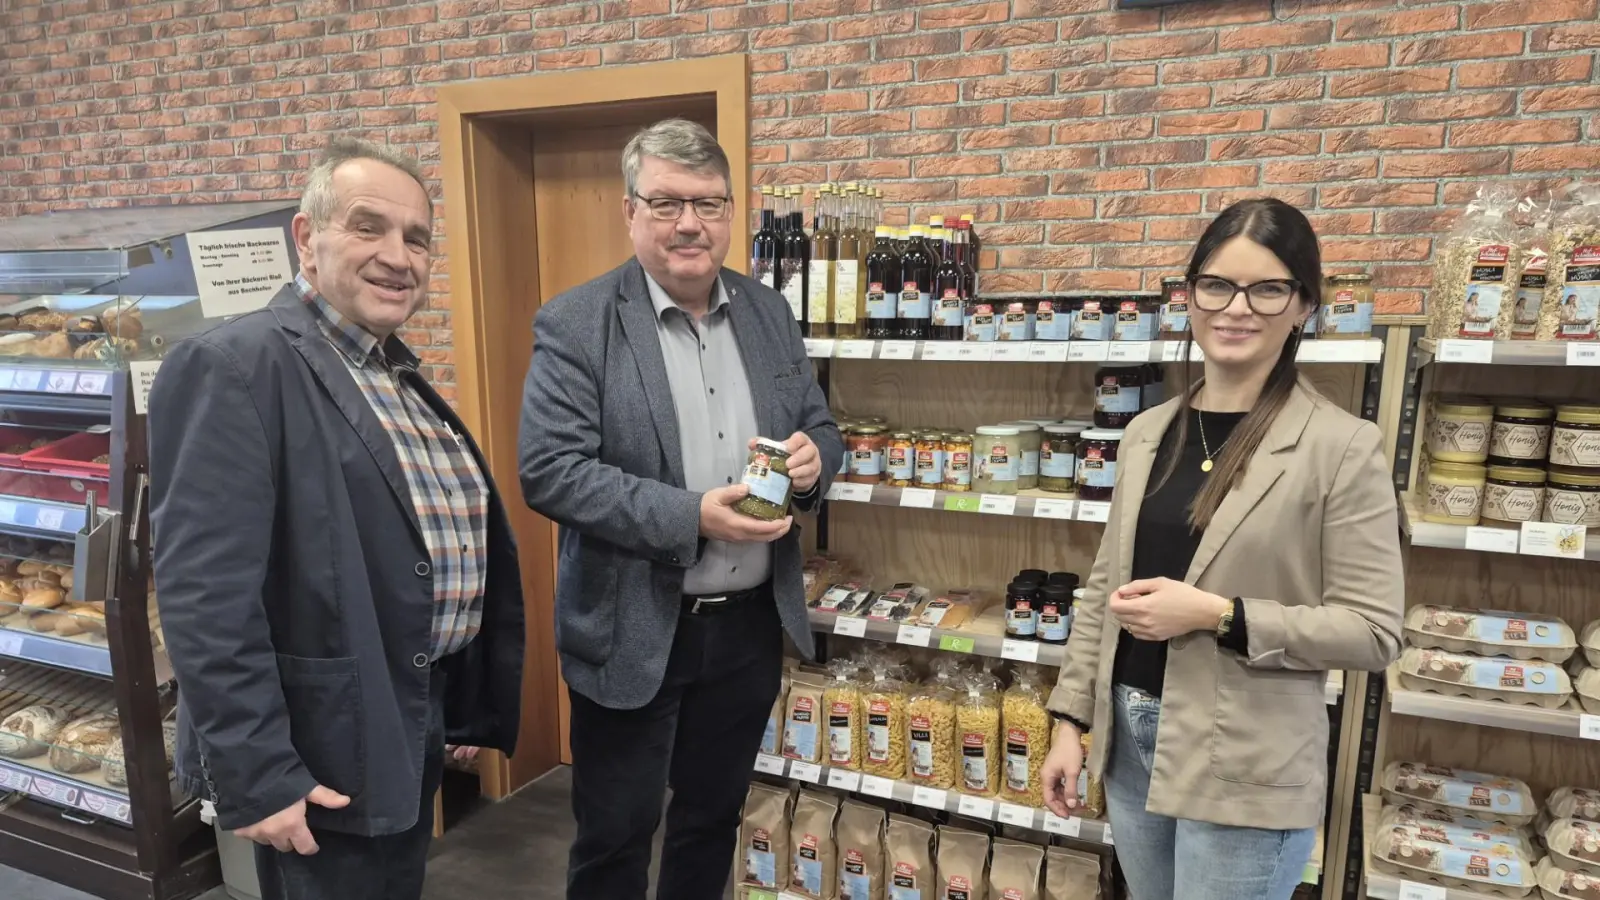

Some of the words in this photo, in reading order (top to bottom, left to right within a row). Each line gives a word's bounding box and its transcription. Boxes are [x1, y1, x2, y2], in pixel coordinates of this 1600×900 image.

[198, 244, 223, 252] Täglich
[242, 276, 268, 284] Bäckerei
[1458, 430, 1484, 443] Honig
[1508, 435, 1537, 448] Honig
[1449, 494, 1476, 507] Honig
[1507, 497, 1535, 510] Honig
[1553, 500, 1581, 514] Honig
